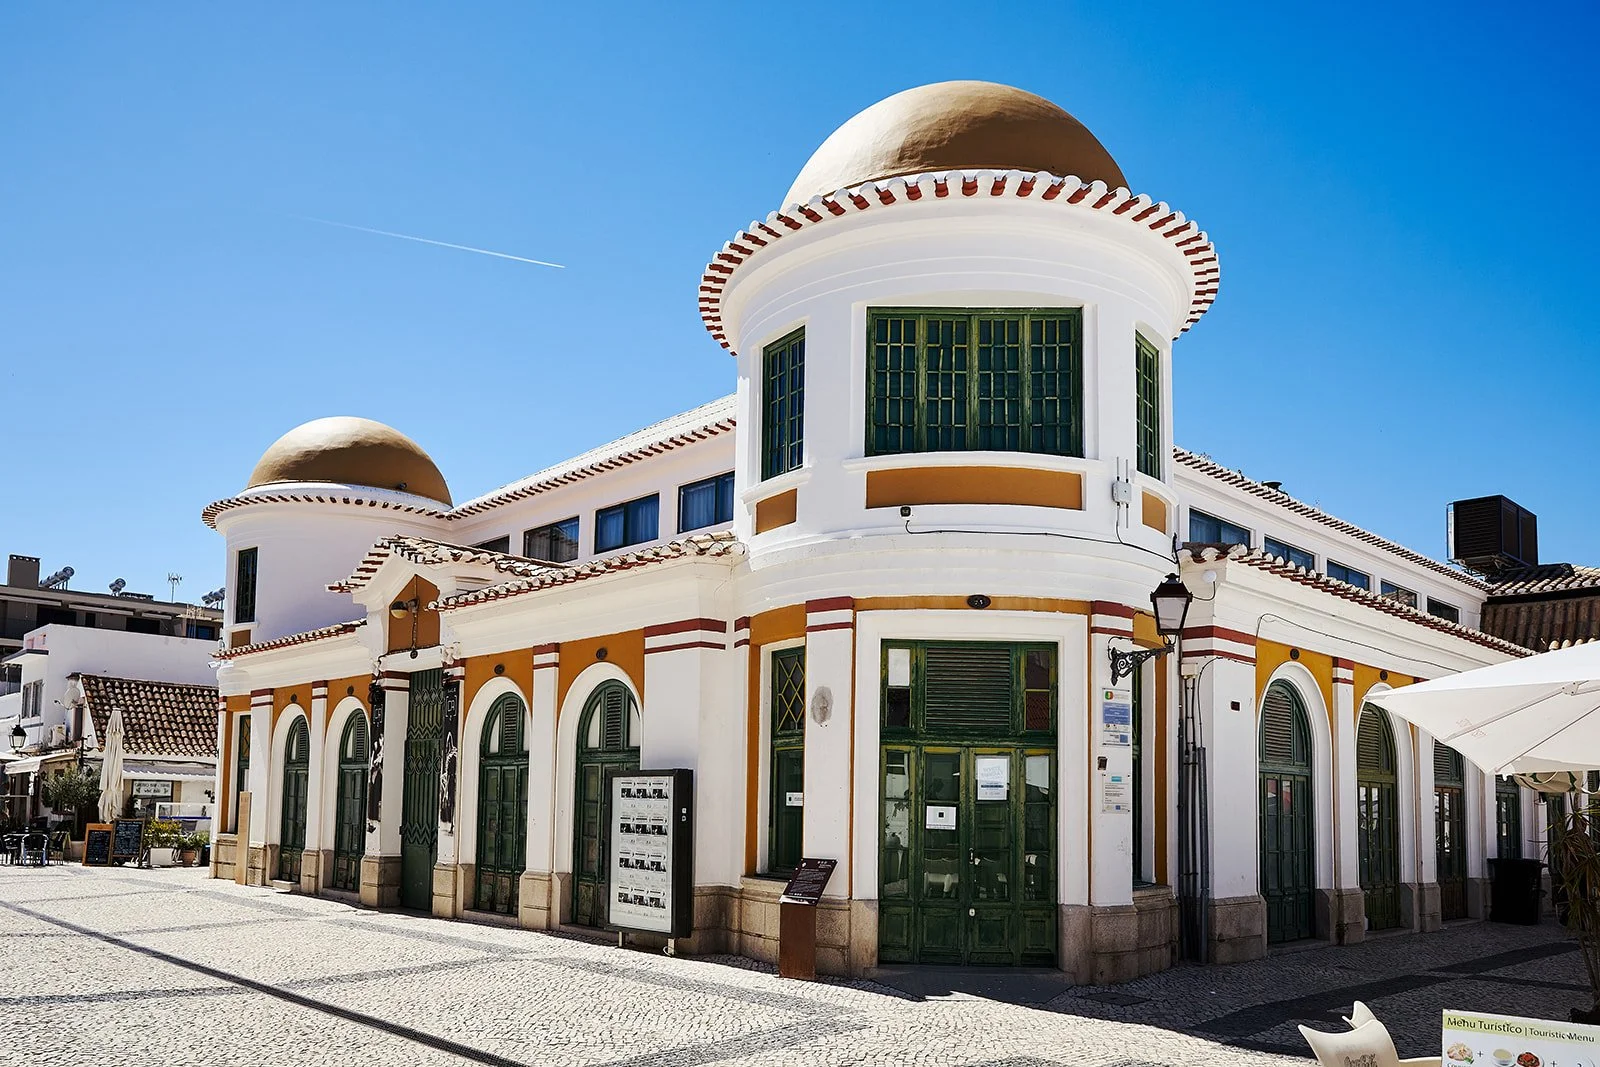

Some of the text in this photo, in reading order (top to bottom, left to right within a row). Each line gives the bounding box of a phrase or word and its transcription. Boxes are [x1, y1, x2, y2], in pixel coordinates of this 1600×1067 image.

[1447, 1017, 1476, 1029] Menu
[1529, 1027, 1566, 1040] Touristic
[1567, 1032, 1595, 1043] Menu
